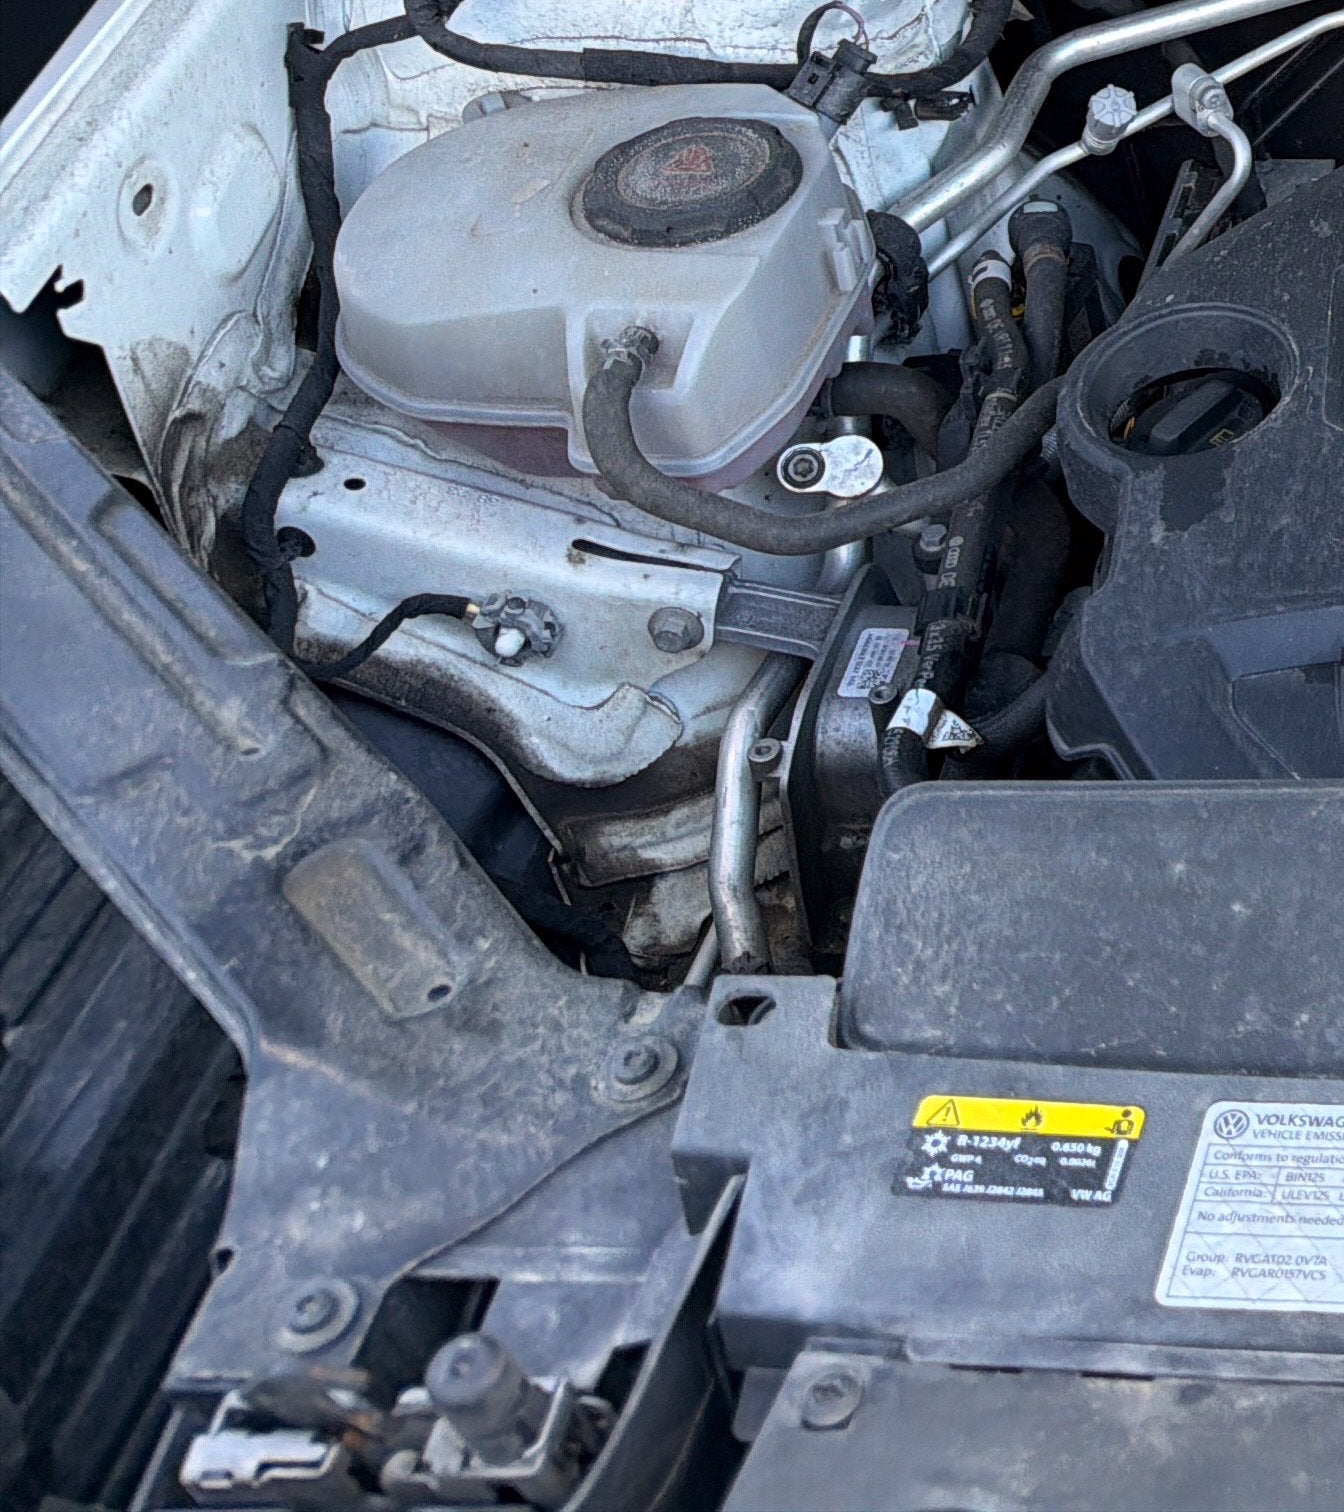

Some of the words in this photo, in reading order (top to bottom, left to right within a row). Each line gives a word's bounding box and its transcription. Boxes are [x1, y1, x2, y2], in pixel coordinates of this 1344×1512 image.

[1252, 1129, 1302, 1141] VEHICLE
[957, 1134, 1022, 1153] R-1234yf
[1086, 1143, 1102, 1157] kg
[1213, 1149, 1273, 1162] Conforms
[1276, 1151, 1289, 1162] to
[945, 1169, 975, 1182] PAG
[1208, 1169, 1230, 1180] U.S.
[1285, 1171, 1326, 1183] BIN125
[1070, 1188, 1093, 1201] VW
[1093, 1190, 1112, 1202] AG
[1203, 1186, 1267, 1199] California:
[1197, 1210, 1216, 1222] No
[1218, 1210, 1295, 1225] adjustments
[1186, 1250, 1229, 1264] Group:
[1181, 1264, 1217, 1278] Evap:
